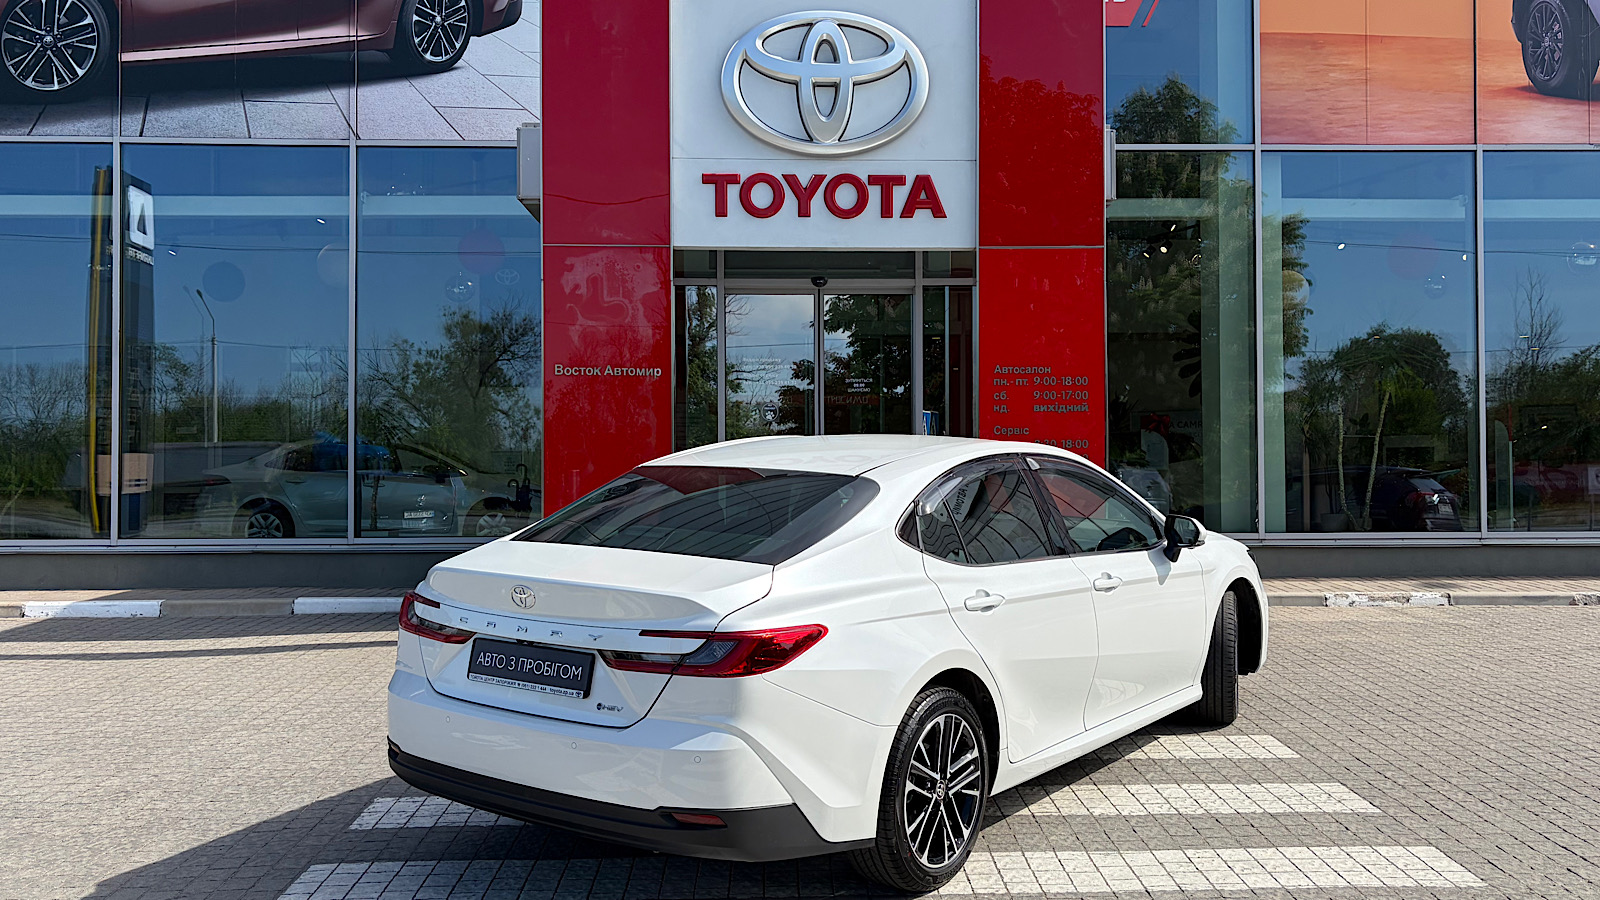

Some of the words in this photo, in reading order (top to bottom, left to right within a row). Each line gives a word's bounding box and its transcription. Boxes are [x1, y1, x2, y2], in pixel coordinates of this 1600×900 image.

[702, 172, 947, 219] TOYOTA
[554, 364, 602, 376] Восток
[604, 364, 662, 380] Автомир
[993, 364, 1052, 375] Автосалон
[1033, 376, 1089, 387] 9:00-18:00
[993, 390, 1010, 401] сб.
[1033, 390, 1089, 401] 9:00-17:00
[993, 405, 1010, 415] нд.
[1033, 401, 1089, 415] вихідний
[993, 425, 1030, 438] Сервіс
[459, 617, 603, 641] CAMRY
[476, 651, 507, 670] АВТО
[517, 656, 583, 682] ПРОБІГОМ
